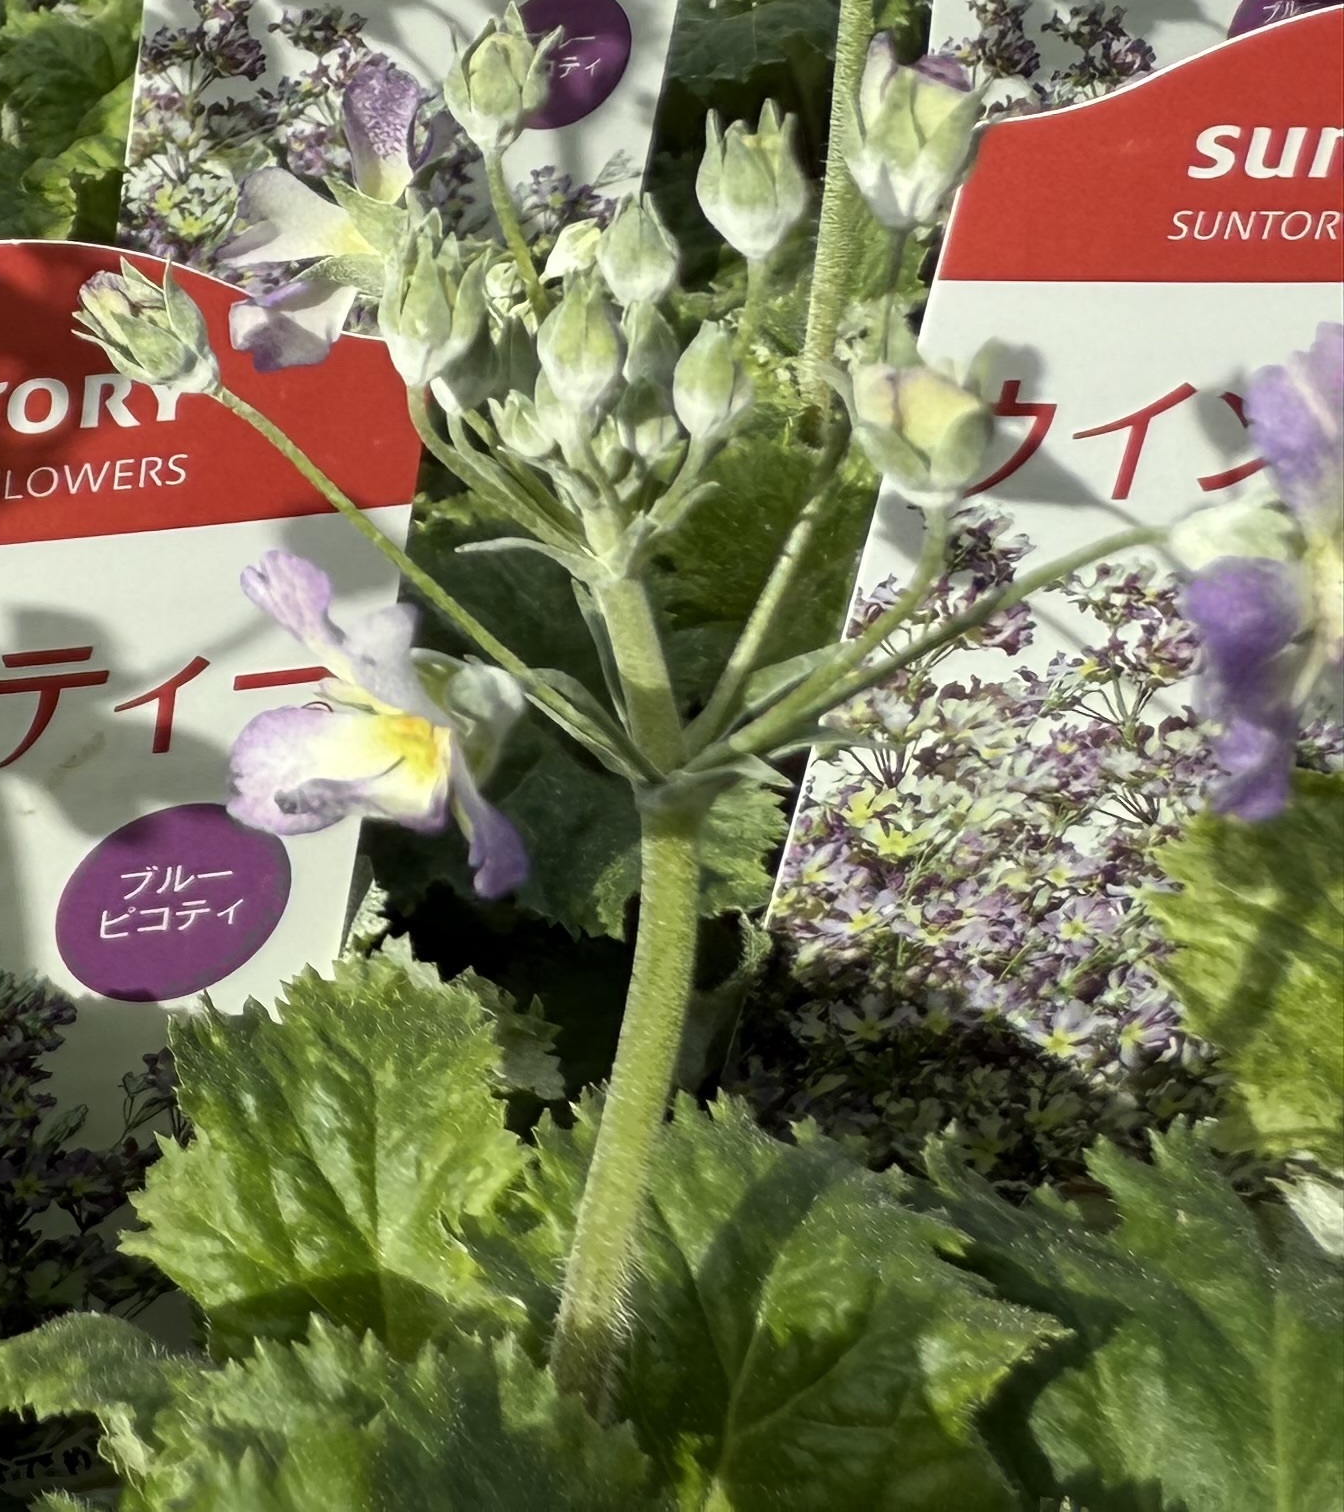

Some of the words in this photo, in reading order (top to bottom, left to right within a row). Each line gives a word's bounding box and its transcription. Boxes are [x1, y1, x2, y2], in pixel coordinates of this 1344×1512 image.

[1167, 210, 1340, 241] SUNTOR
[120, 868, 235, 903] ブルー
[99, 899, 239, 941] ピコティ
